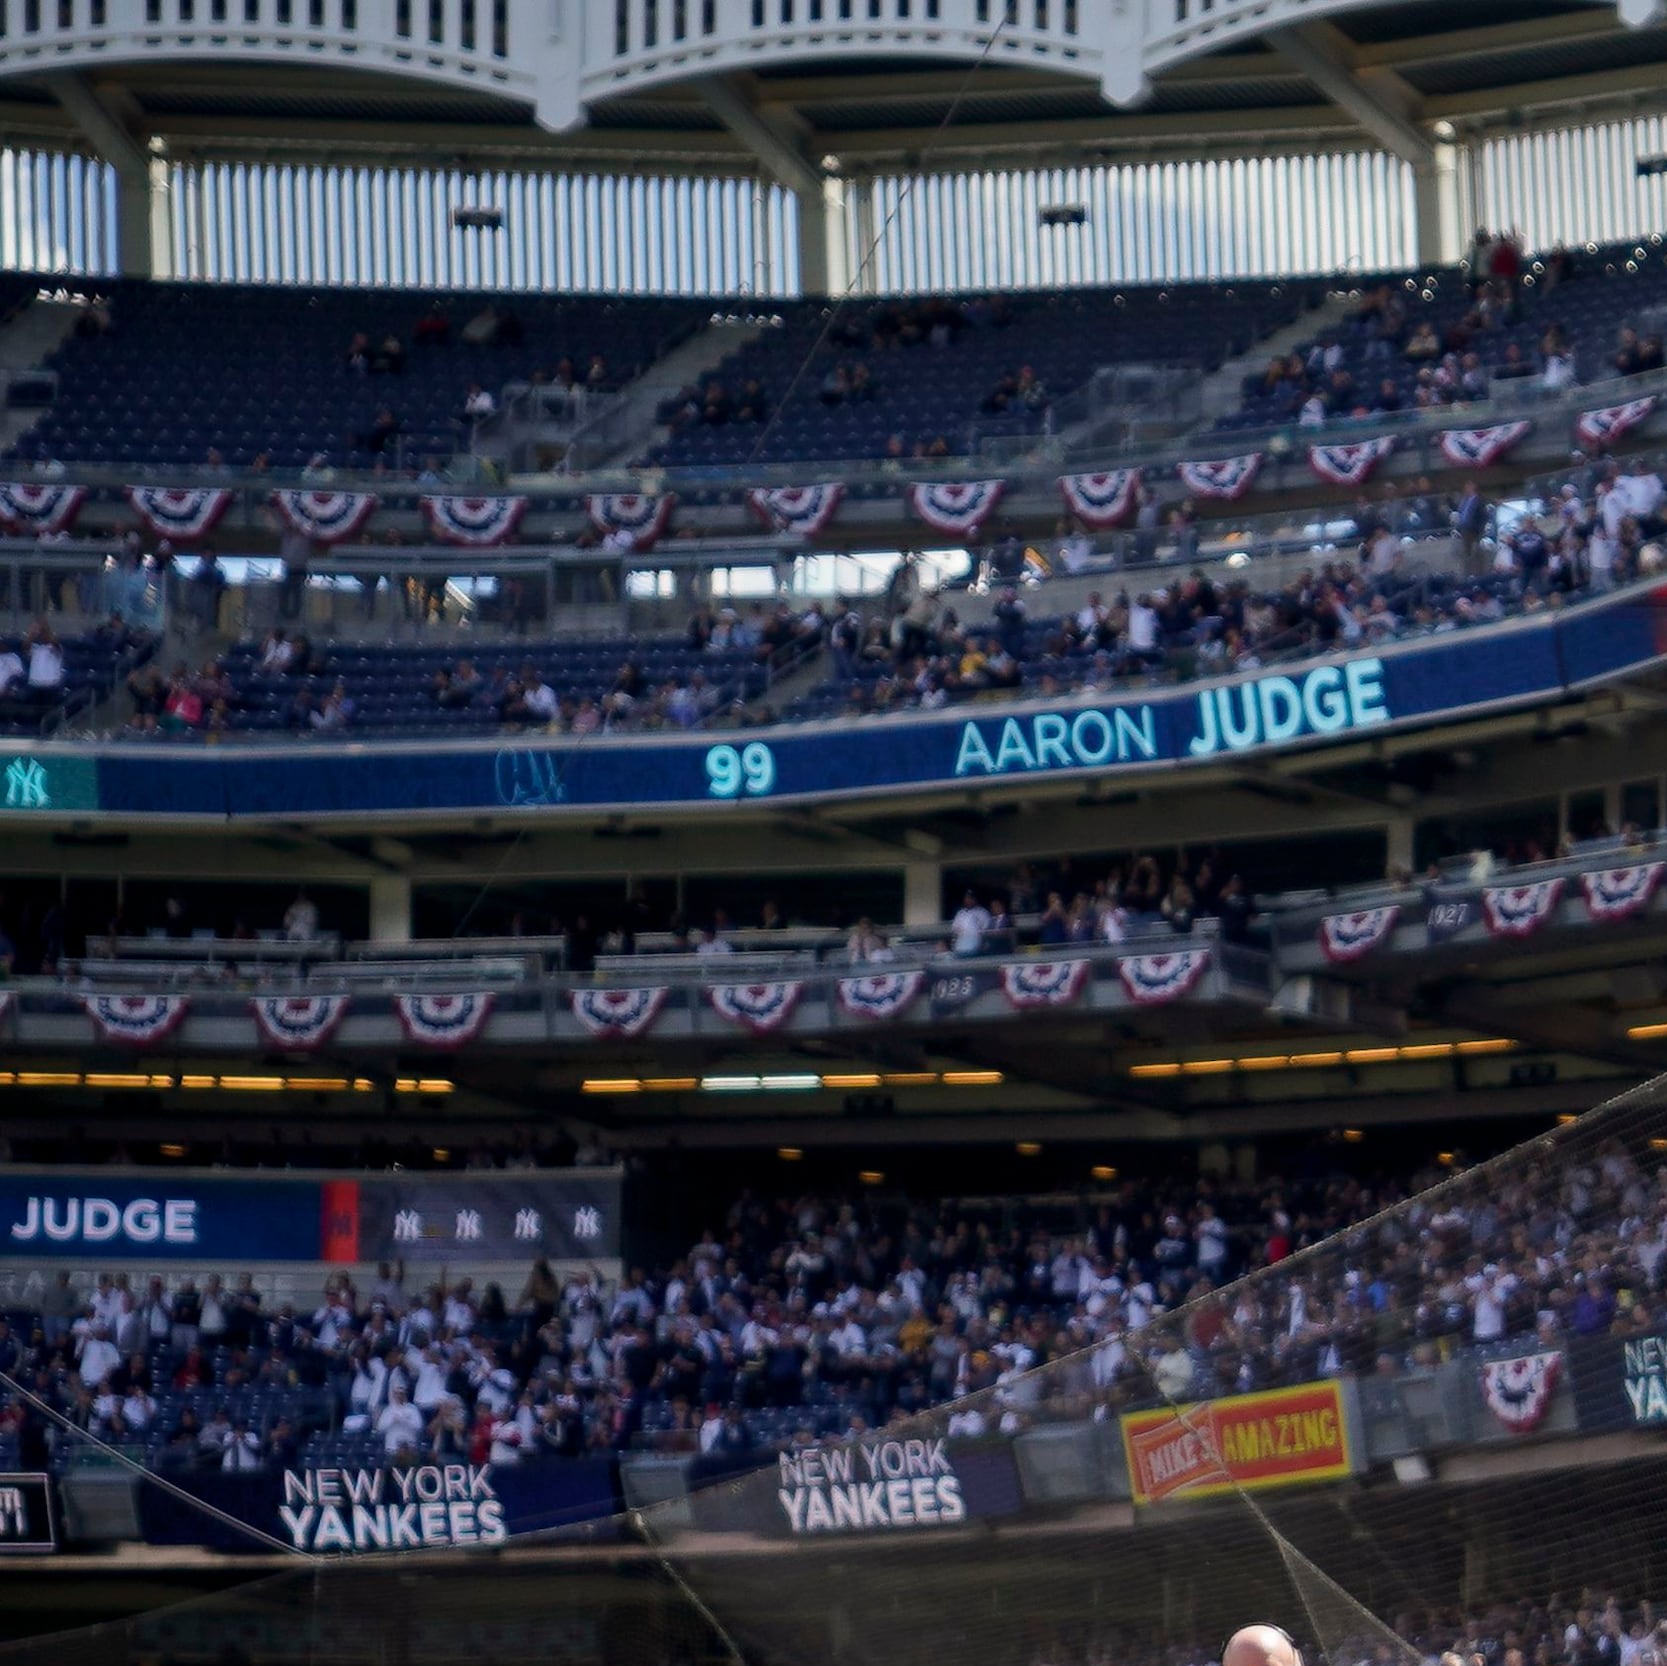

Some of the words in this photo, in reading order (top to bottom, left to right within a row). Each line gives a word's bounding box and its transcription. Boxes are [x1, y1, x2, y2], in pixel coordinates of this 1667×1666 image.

[955, 704, 1156, 775] AARON
[1190, 658, 1389, 756] JUDGE
[705, 742, 776, 797] 99
[11, 1196, 198, 1244] JUDGE
[779, 1447, 852, 1488] NEW
[863, 1438, 953, 1479] YORK
[1148, 1426, 1216, 1481] MIKE'S
[1221, 1408, 1339, 1465] AMAZING
[282, 1467, 385, 1504] NEW
[392, 1463, 498, 1500] YORK
[778, 1477, 966, 1533] YANKEES
[278, 1500, 507, 1550] YANKEES
